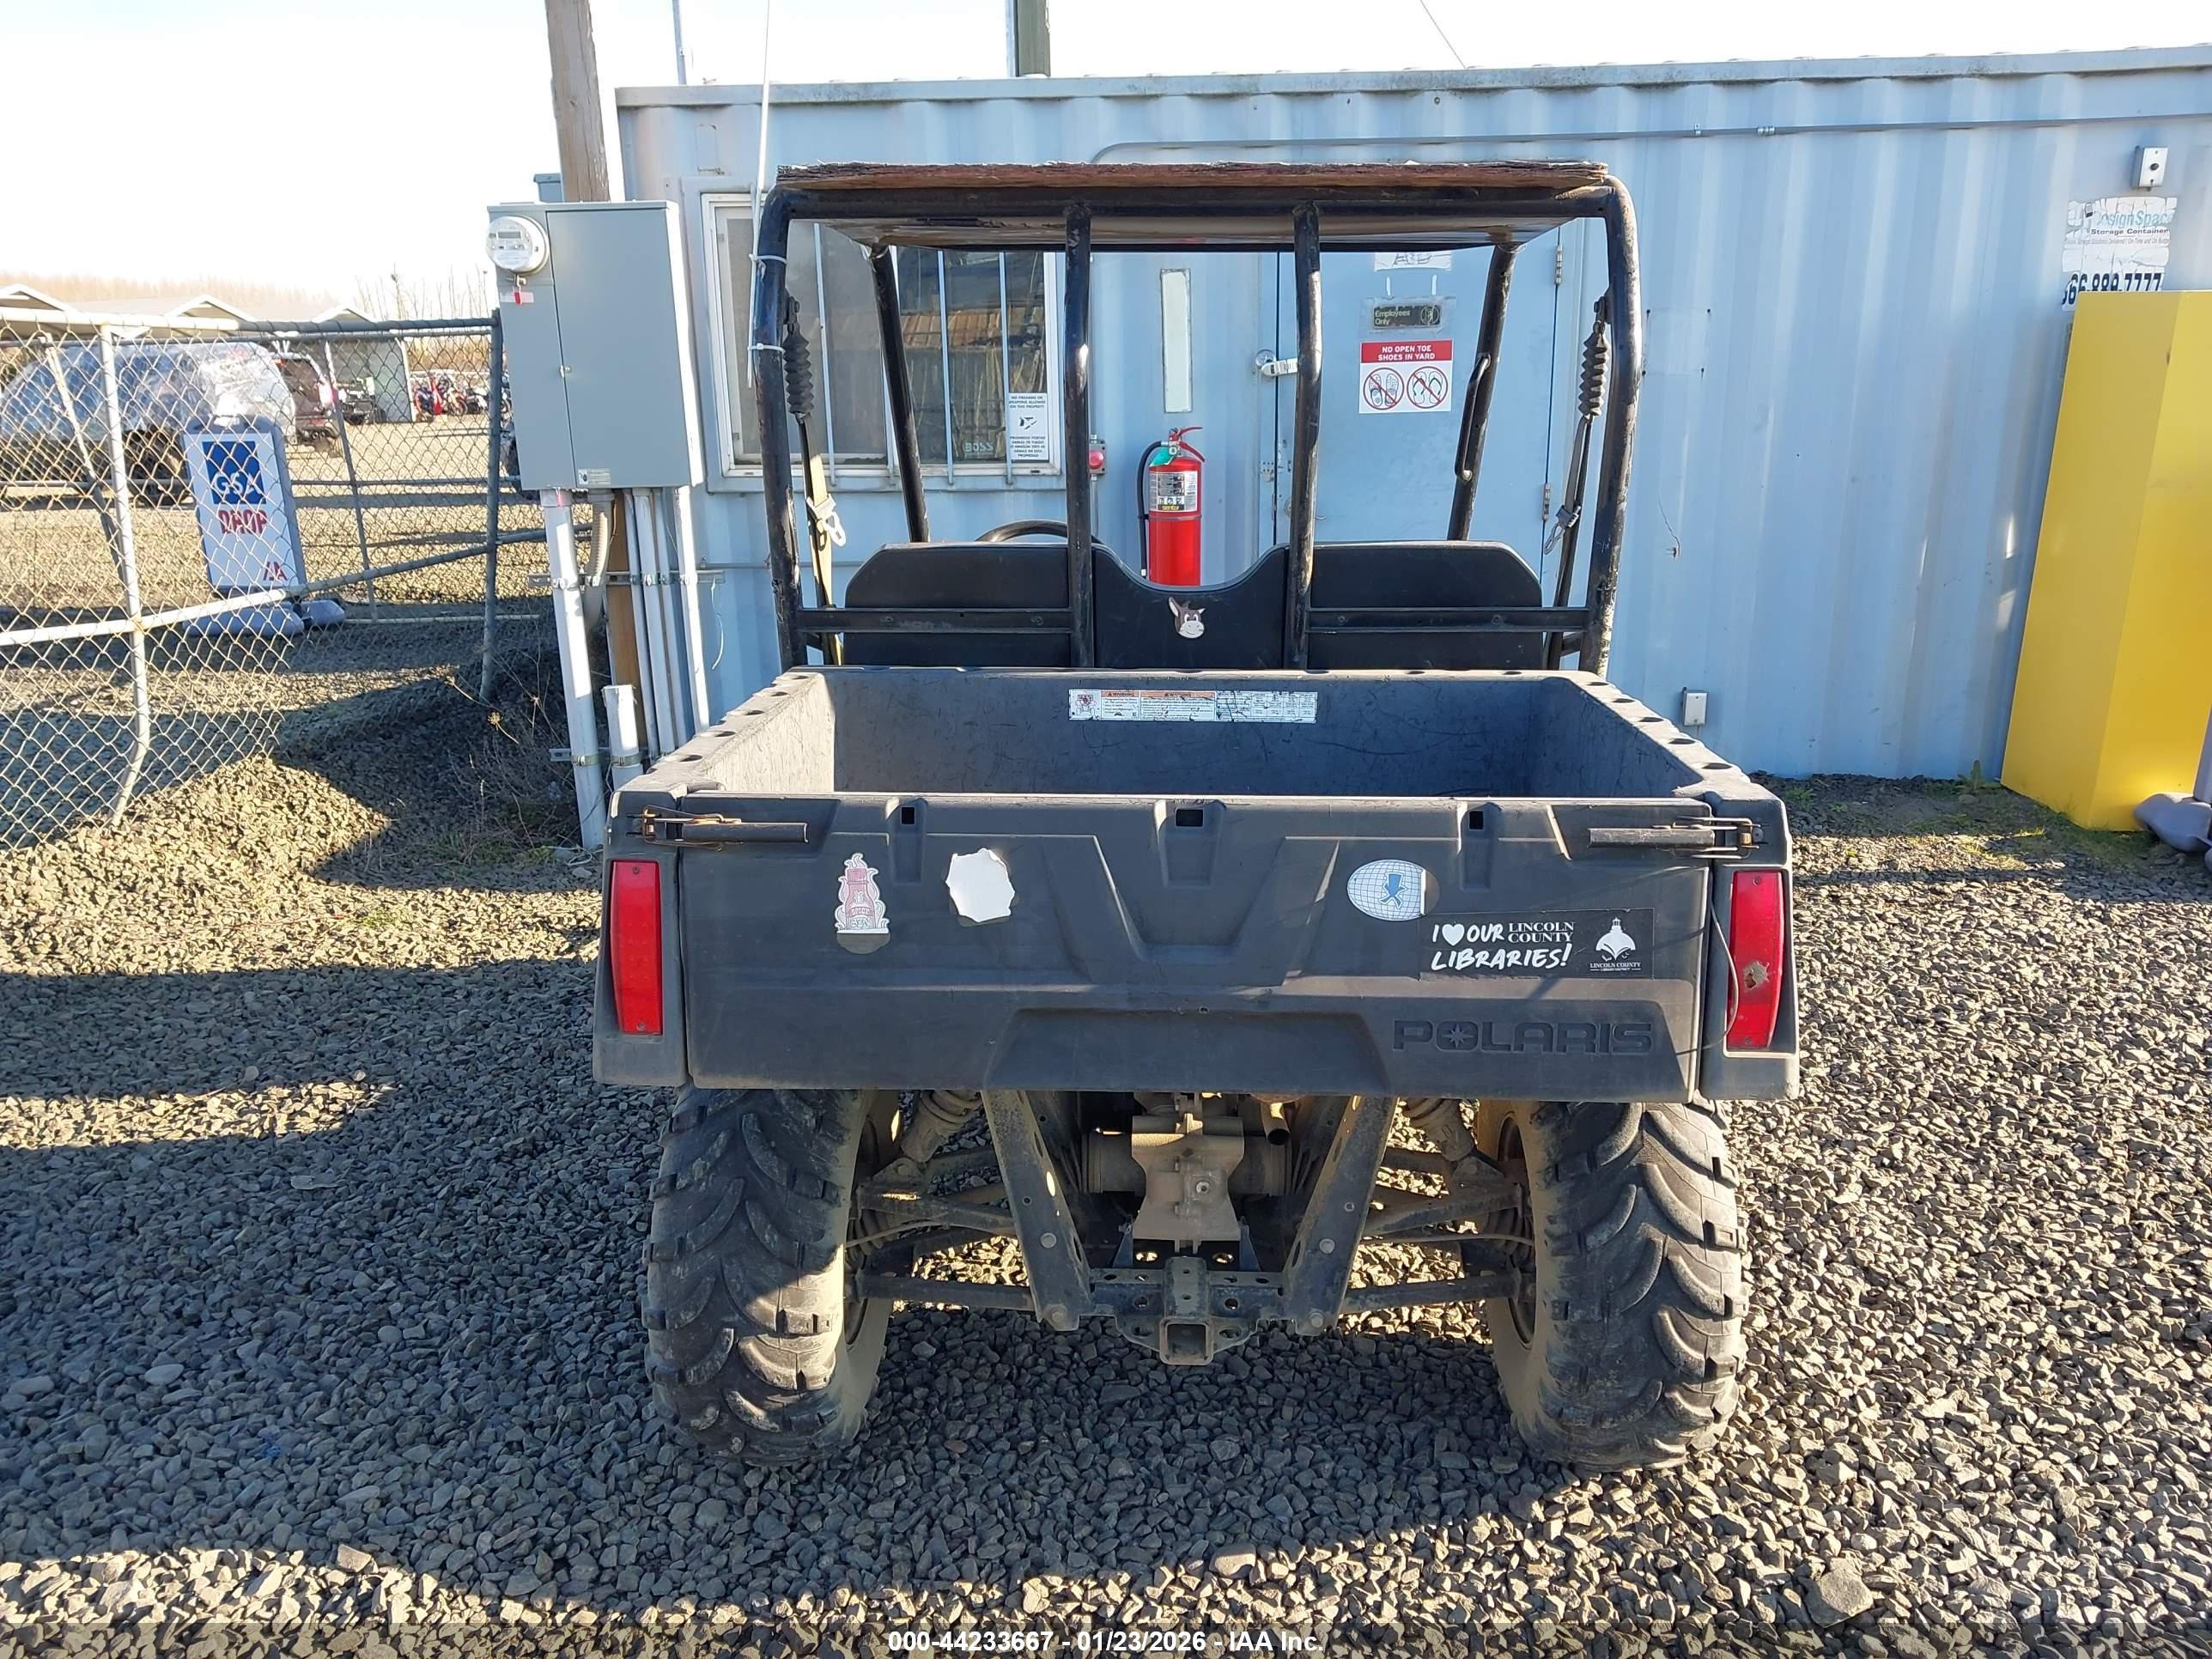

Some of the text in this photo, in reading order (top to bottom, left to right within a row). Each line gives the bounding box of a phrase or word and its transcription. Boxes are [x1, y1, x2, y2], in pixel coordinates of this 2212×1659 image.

[1375, 309, 1411, 319] Employees
[965, 441, 994, 453] BOSS
[214, 471, 263, 495] GSA
[218, 508, 268, 535] DROP
[851, 907, 870, 915] SPICY
[1432, 923, 1504, 943] I OUR
[1509, 921, 1576, 933] LINCOLN
[1508, 932, 1573, 944] COUNTY
[1431, 943, 1572, 970] LIBRARIES!
[1391, 1018, 1653, 1056] POLARIS
